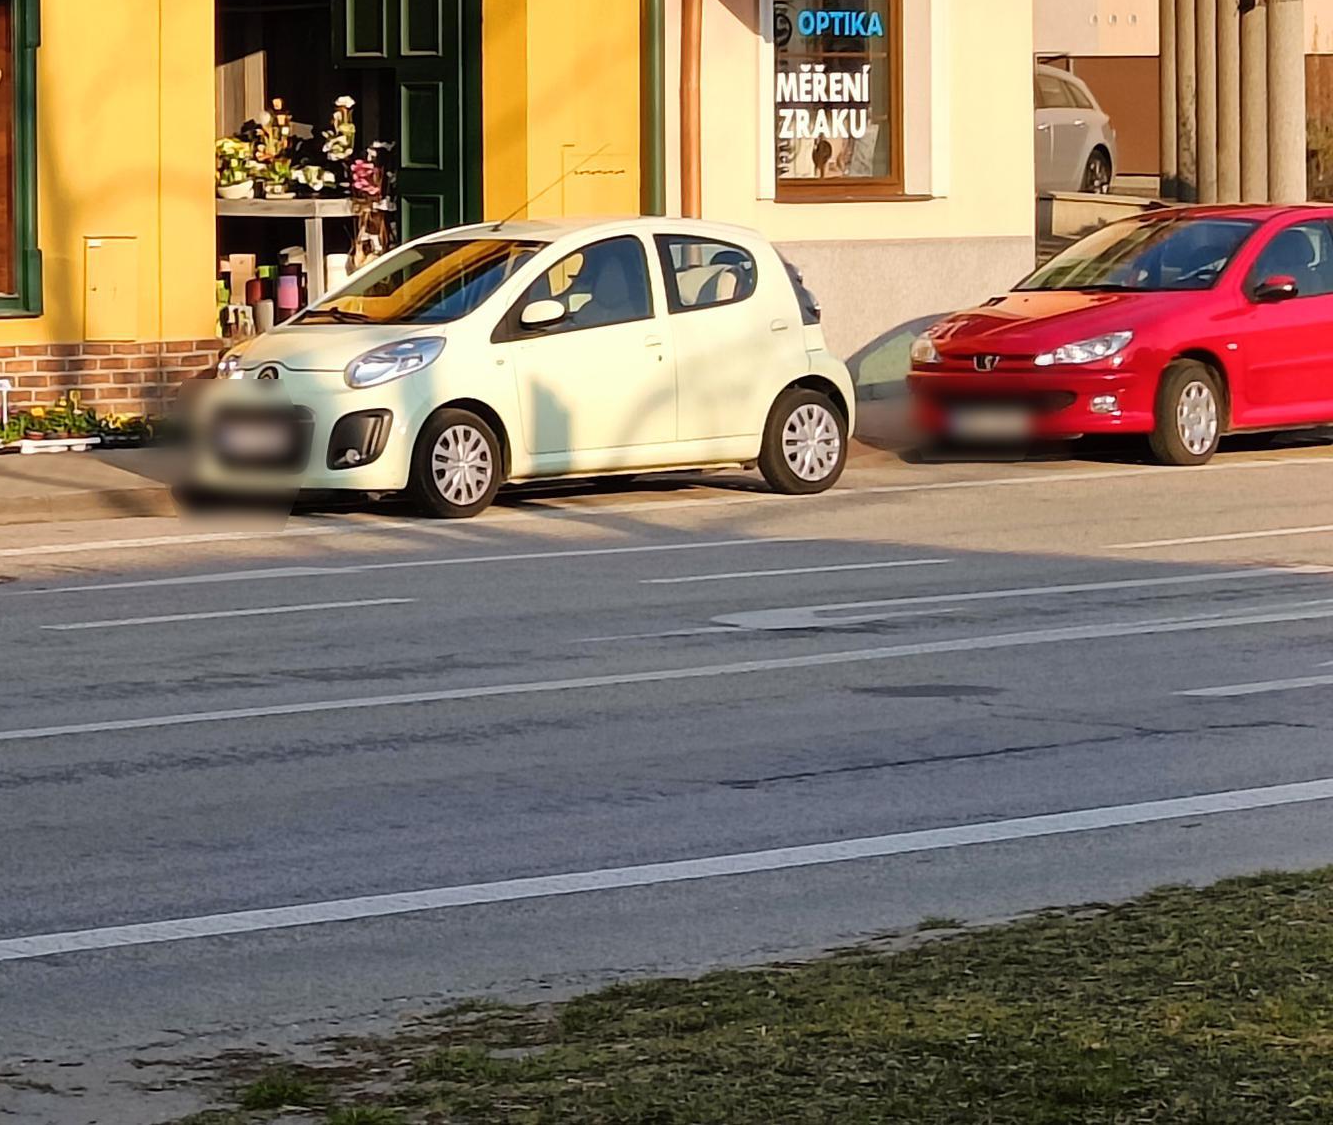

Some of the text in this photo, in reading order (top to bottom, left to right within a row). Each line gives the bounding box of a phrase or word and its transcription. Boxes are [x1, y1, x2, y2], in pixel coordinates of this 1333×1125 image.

[797, 10, 884, 37] OPTIKA
[776, 63, 871, 103] MĚŘENÍ
[779, 108, 868, 139] ZRAKU
